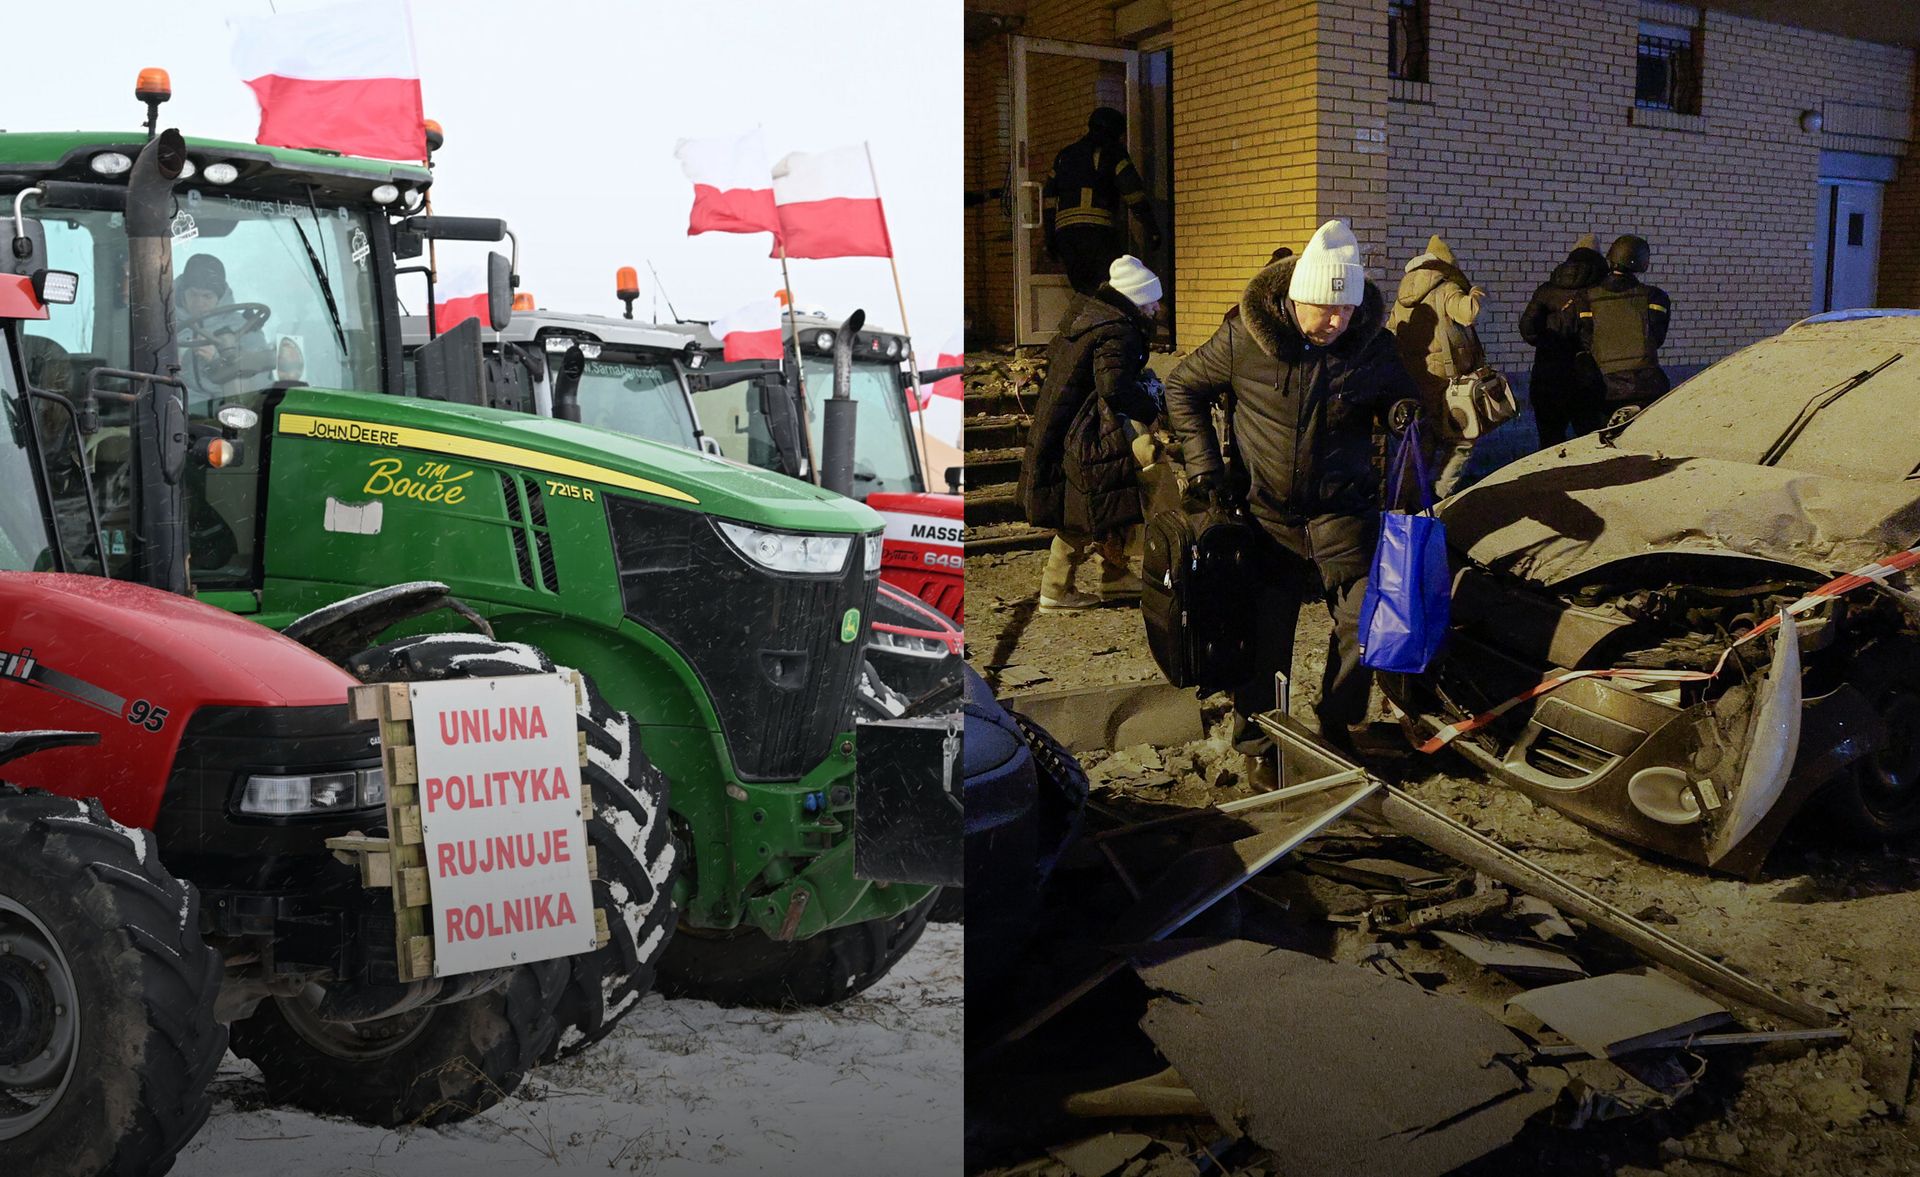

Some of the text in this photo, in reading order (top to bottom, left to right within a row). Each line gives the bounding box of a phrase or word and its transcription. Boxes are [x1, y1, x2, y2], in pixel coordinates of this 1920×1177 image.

[225, 193, 274, 216] Jacques
[277, 199, 322, 219] Lebauy
[308, 420, 399, 445] JOHN DEERE
[417, 462, 451, 480] JM
[546, 480, 595, 502] 7215 R
[924, 552, 964, 569] 649
[127, 699, 169, 733] 95
[439, 706, 548, 745] UNIJNA
[425, 767, 570, 813] POLITYKA
[437, 829, 570, 878] RUJNUJE
[445, 892, 576, 943] ROLNIKA
